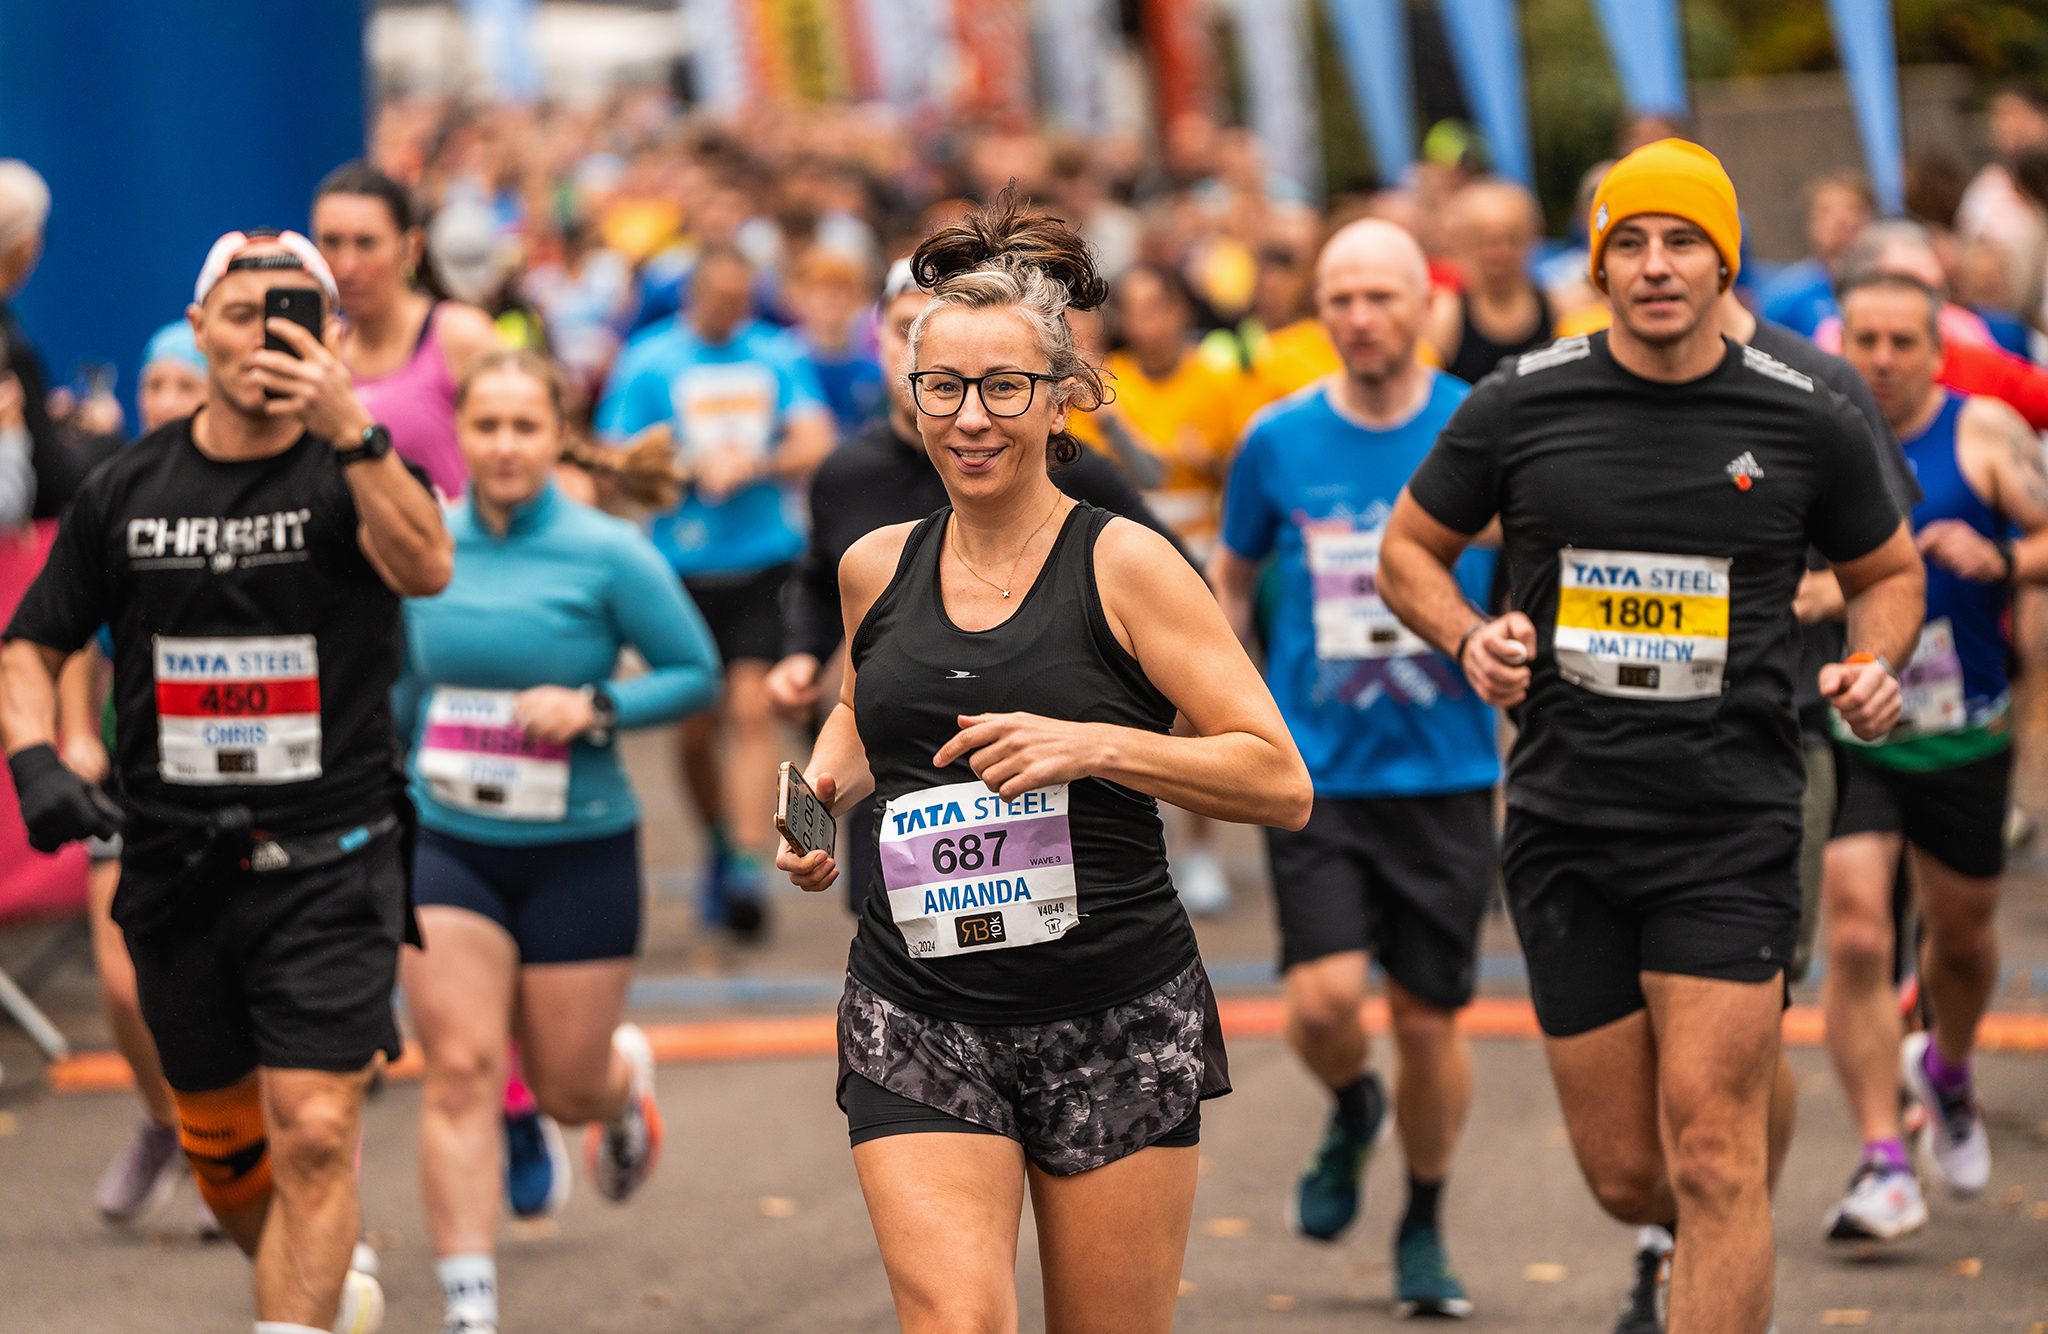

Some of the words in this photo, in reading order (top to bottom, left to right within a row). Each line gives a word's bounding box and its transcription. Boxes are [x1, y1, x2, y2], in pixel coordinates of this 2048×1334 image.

[1572, 563, 1641, 587] TATA
[1651, 568, 1718, 593] STEEL
[1599, 597, 1683, 629] 1801
[165, 653, 230, 673] TATA
[238, 650, 304, 674] STEEL
[1587, 634, 1695, 662] MATTHEW
[201, 683, 269, 715] 450
[203, 721, 268, 746] CHRIS
[892, 801, 966, 836] TATA
[974, 792, 1055, 820] STEEL
[932, 830, 1008, 874] 687
[1029, 856, 1055, 866] WAVE
[924, 877, 1032, 915] AMANDA
[1037, 902, 1065, 917] V40-49
[918, 940, 936, 953] 2024
